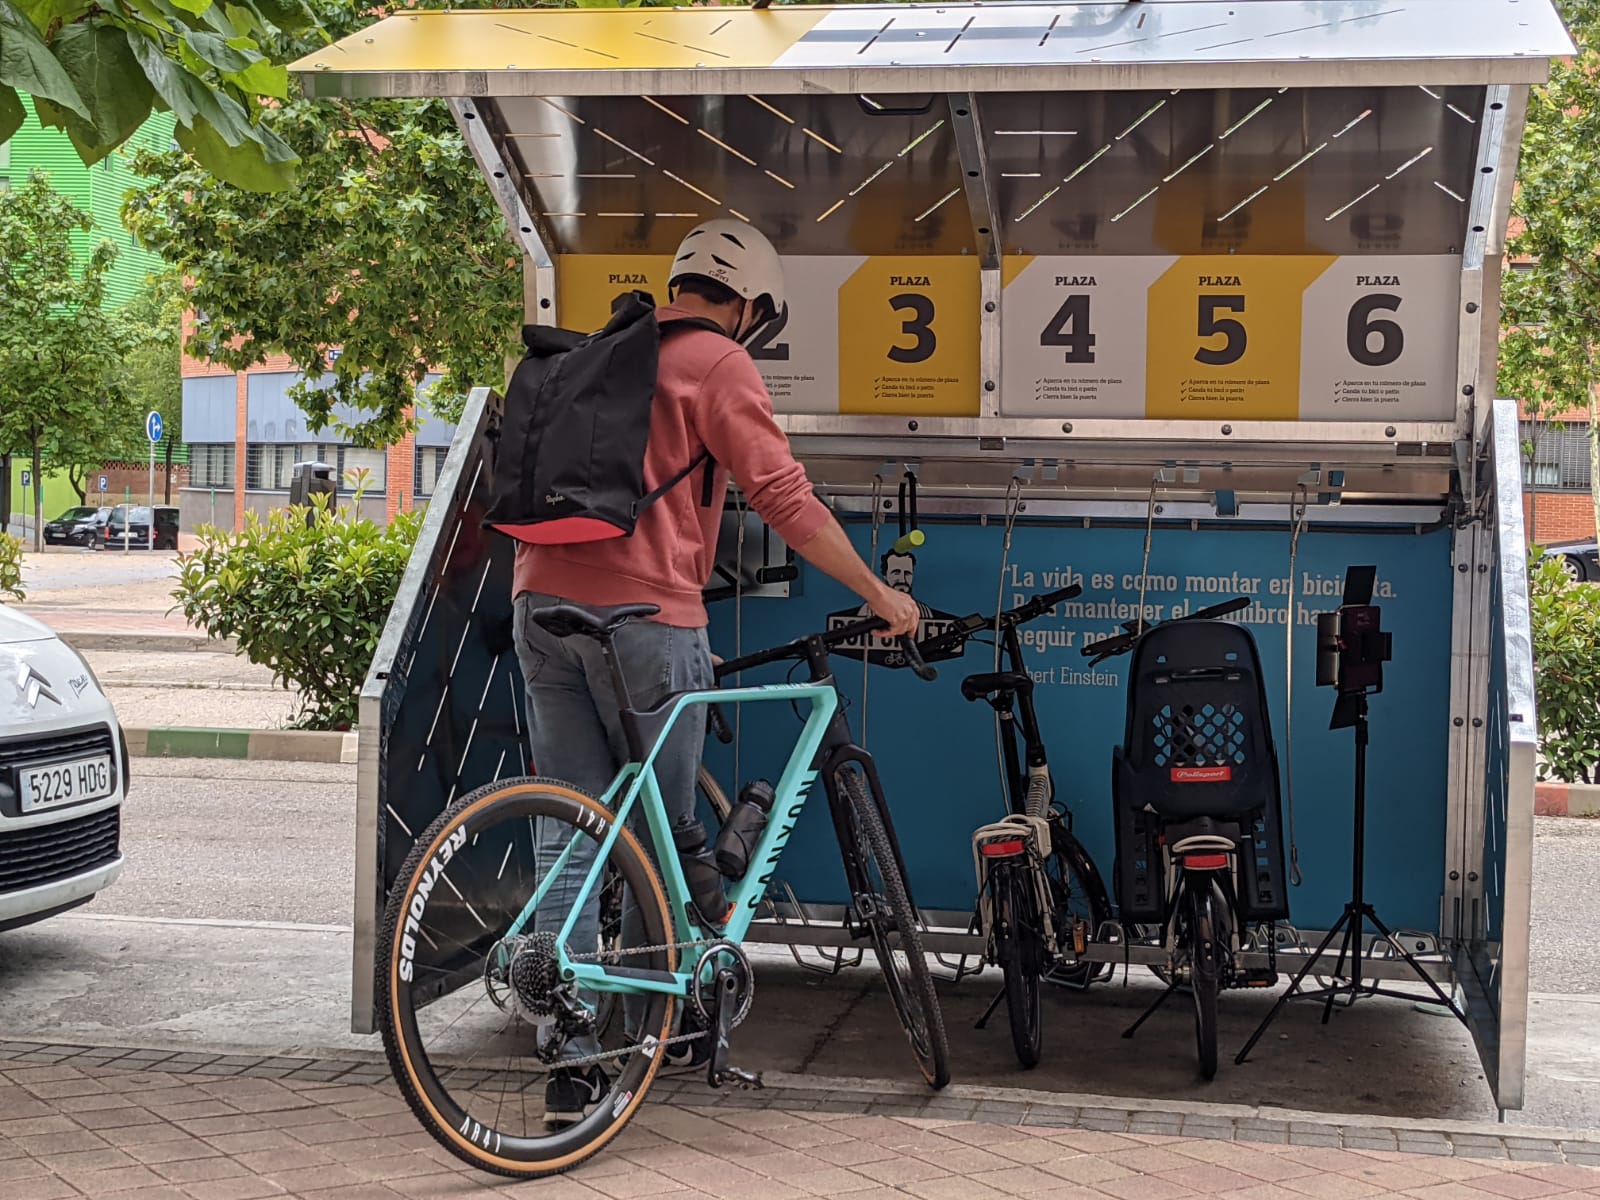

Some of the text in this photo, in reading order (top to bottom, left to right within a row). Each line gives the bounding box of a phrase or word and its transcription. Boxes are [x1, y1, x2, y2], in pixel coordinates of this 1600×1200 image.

[608, 274, 648, 284] PLAZA
[890, 276, 931, 286] PLAZA
[1054, 276, 1097, 286] PLAZA
[1198, 276, 1242, 286] PLAZA
[1356, 275, 1401, 286] PLAZA
[886, 293, 937, 363] 3
[1039, 294, 1096, 364] 4
[1193, 294, 1247, 366] 5
[1346, 293, 1404, 367] 6
[1041, 565, 1083, 589] vida
[1091, 573, 1114, 589] es
[1122, 574, 1178, 592] como
[1185, 571, 1262, 594] montar
[1064, 598, 1165, 621] mantener
[1171, 599, 1190, 620] el
[1060, 666, 1119, 687] Einstein
[30, 762, 107, 803] 5229 HDG
[399, 824, 467, 983] REYNOLDS
